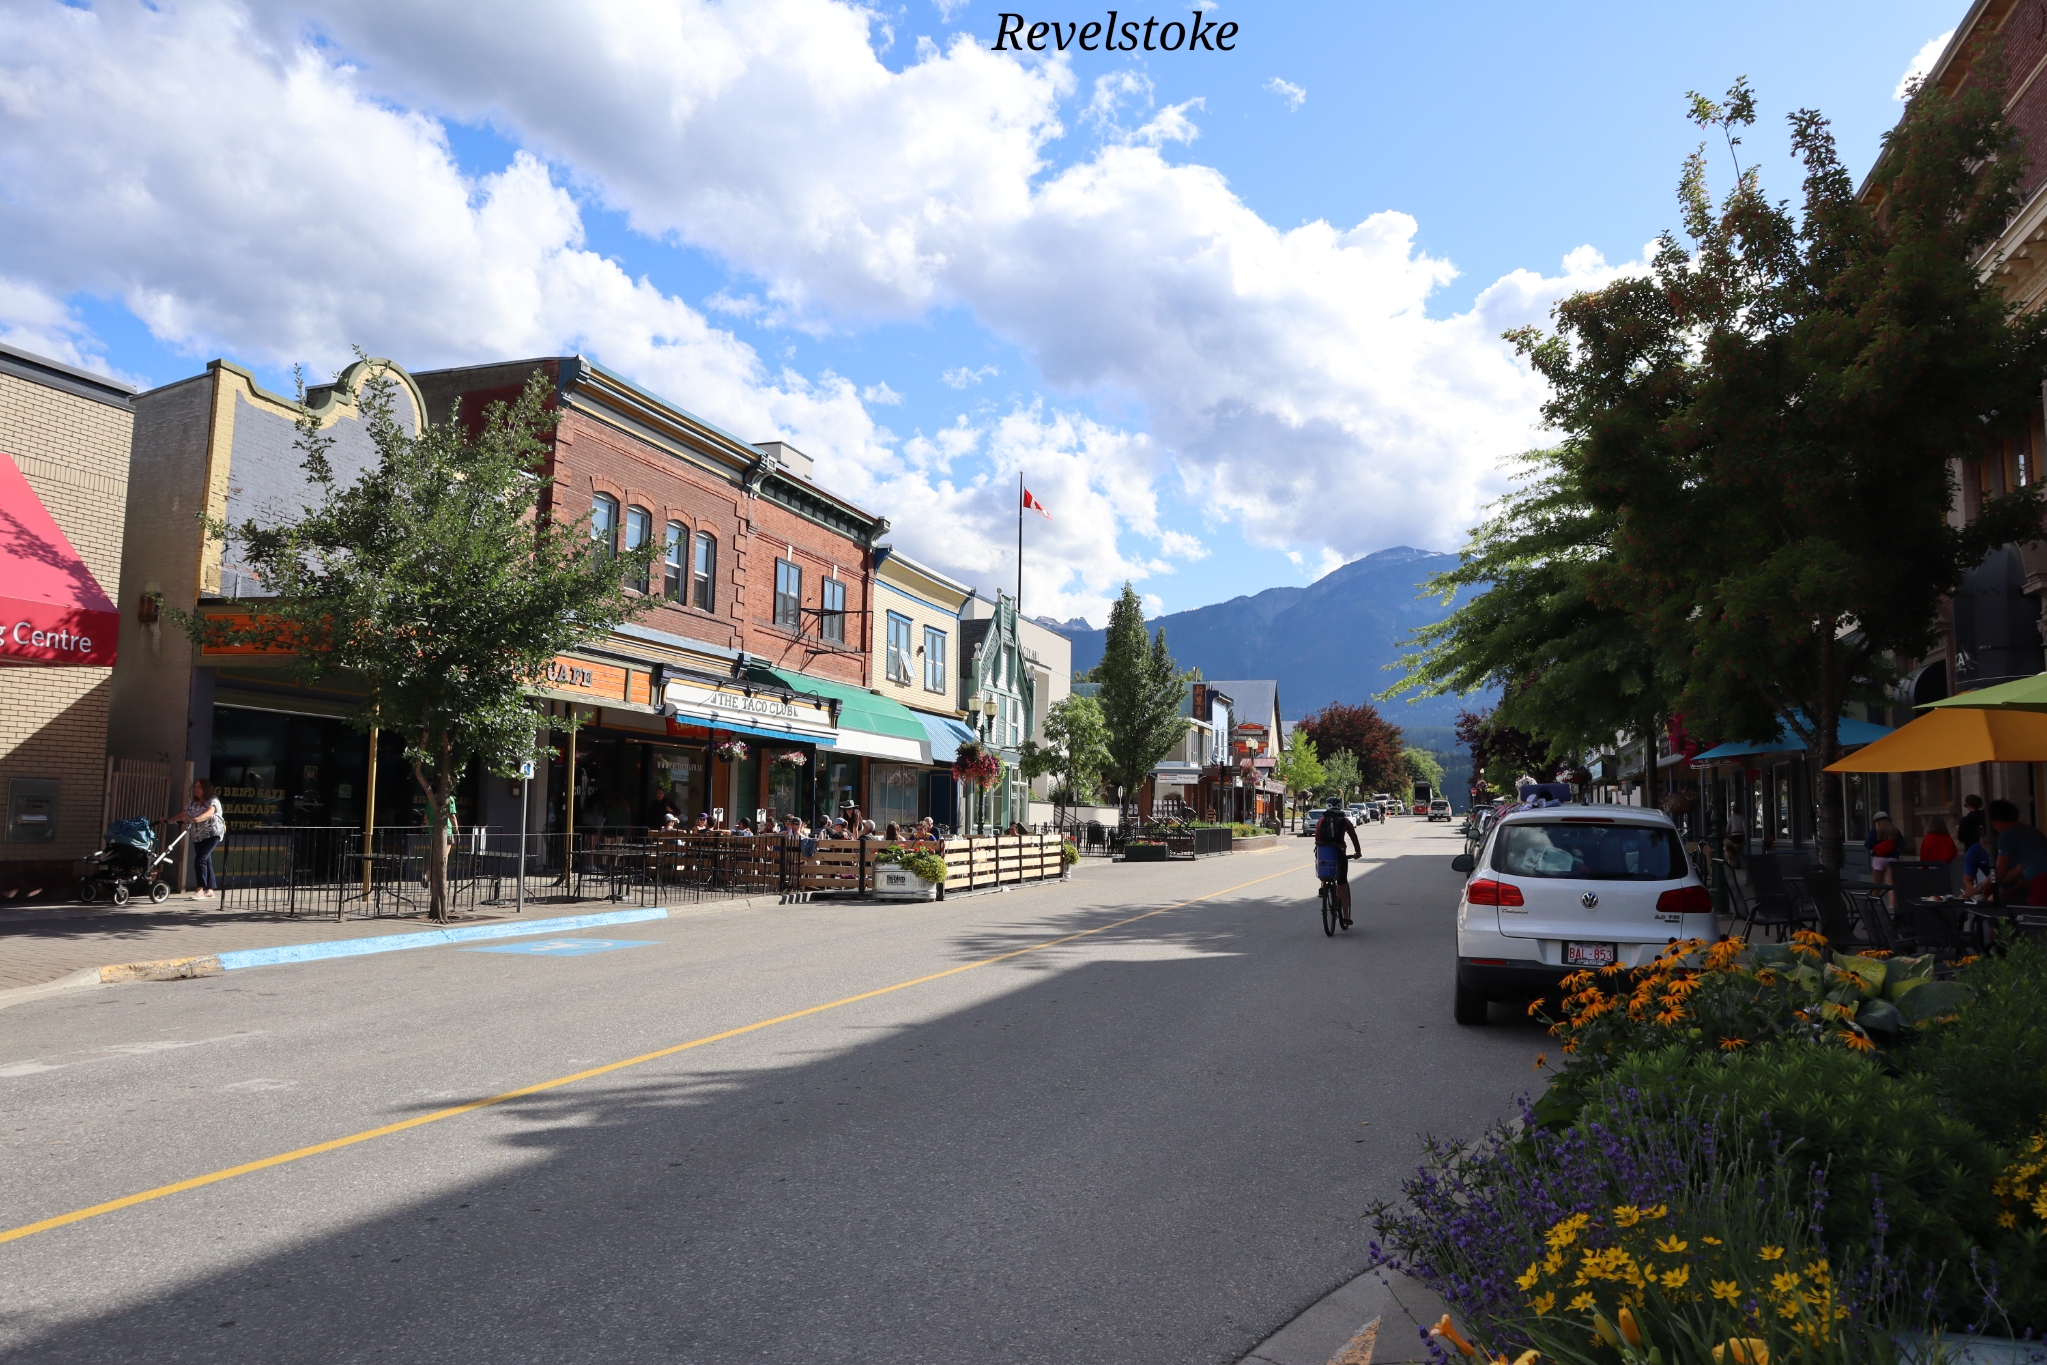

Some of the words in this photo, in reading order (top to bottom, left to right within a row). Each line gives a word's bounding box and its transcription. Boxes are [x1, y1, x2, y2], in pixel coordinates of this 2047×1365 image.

[13, 622, 92, 652] Centre
[547, 661, 593, 687] CAFE
[718, 693, 738, 708] THE
[742, 698, 767, 713] TACO
[770, 702, 794, 717] CLUB
[223, 787, 256, 798] BEND
[257, 788, 286, 799] CAFE
[413, 795, 427, 804] BIG
[222, 803, 278, 815] REAKFAST
